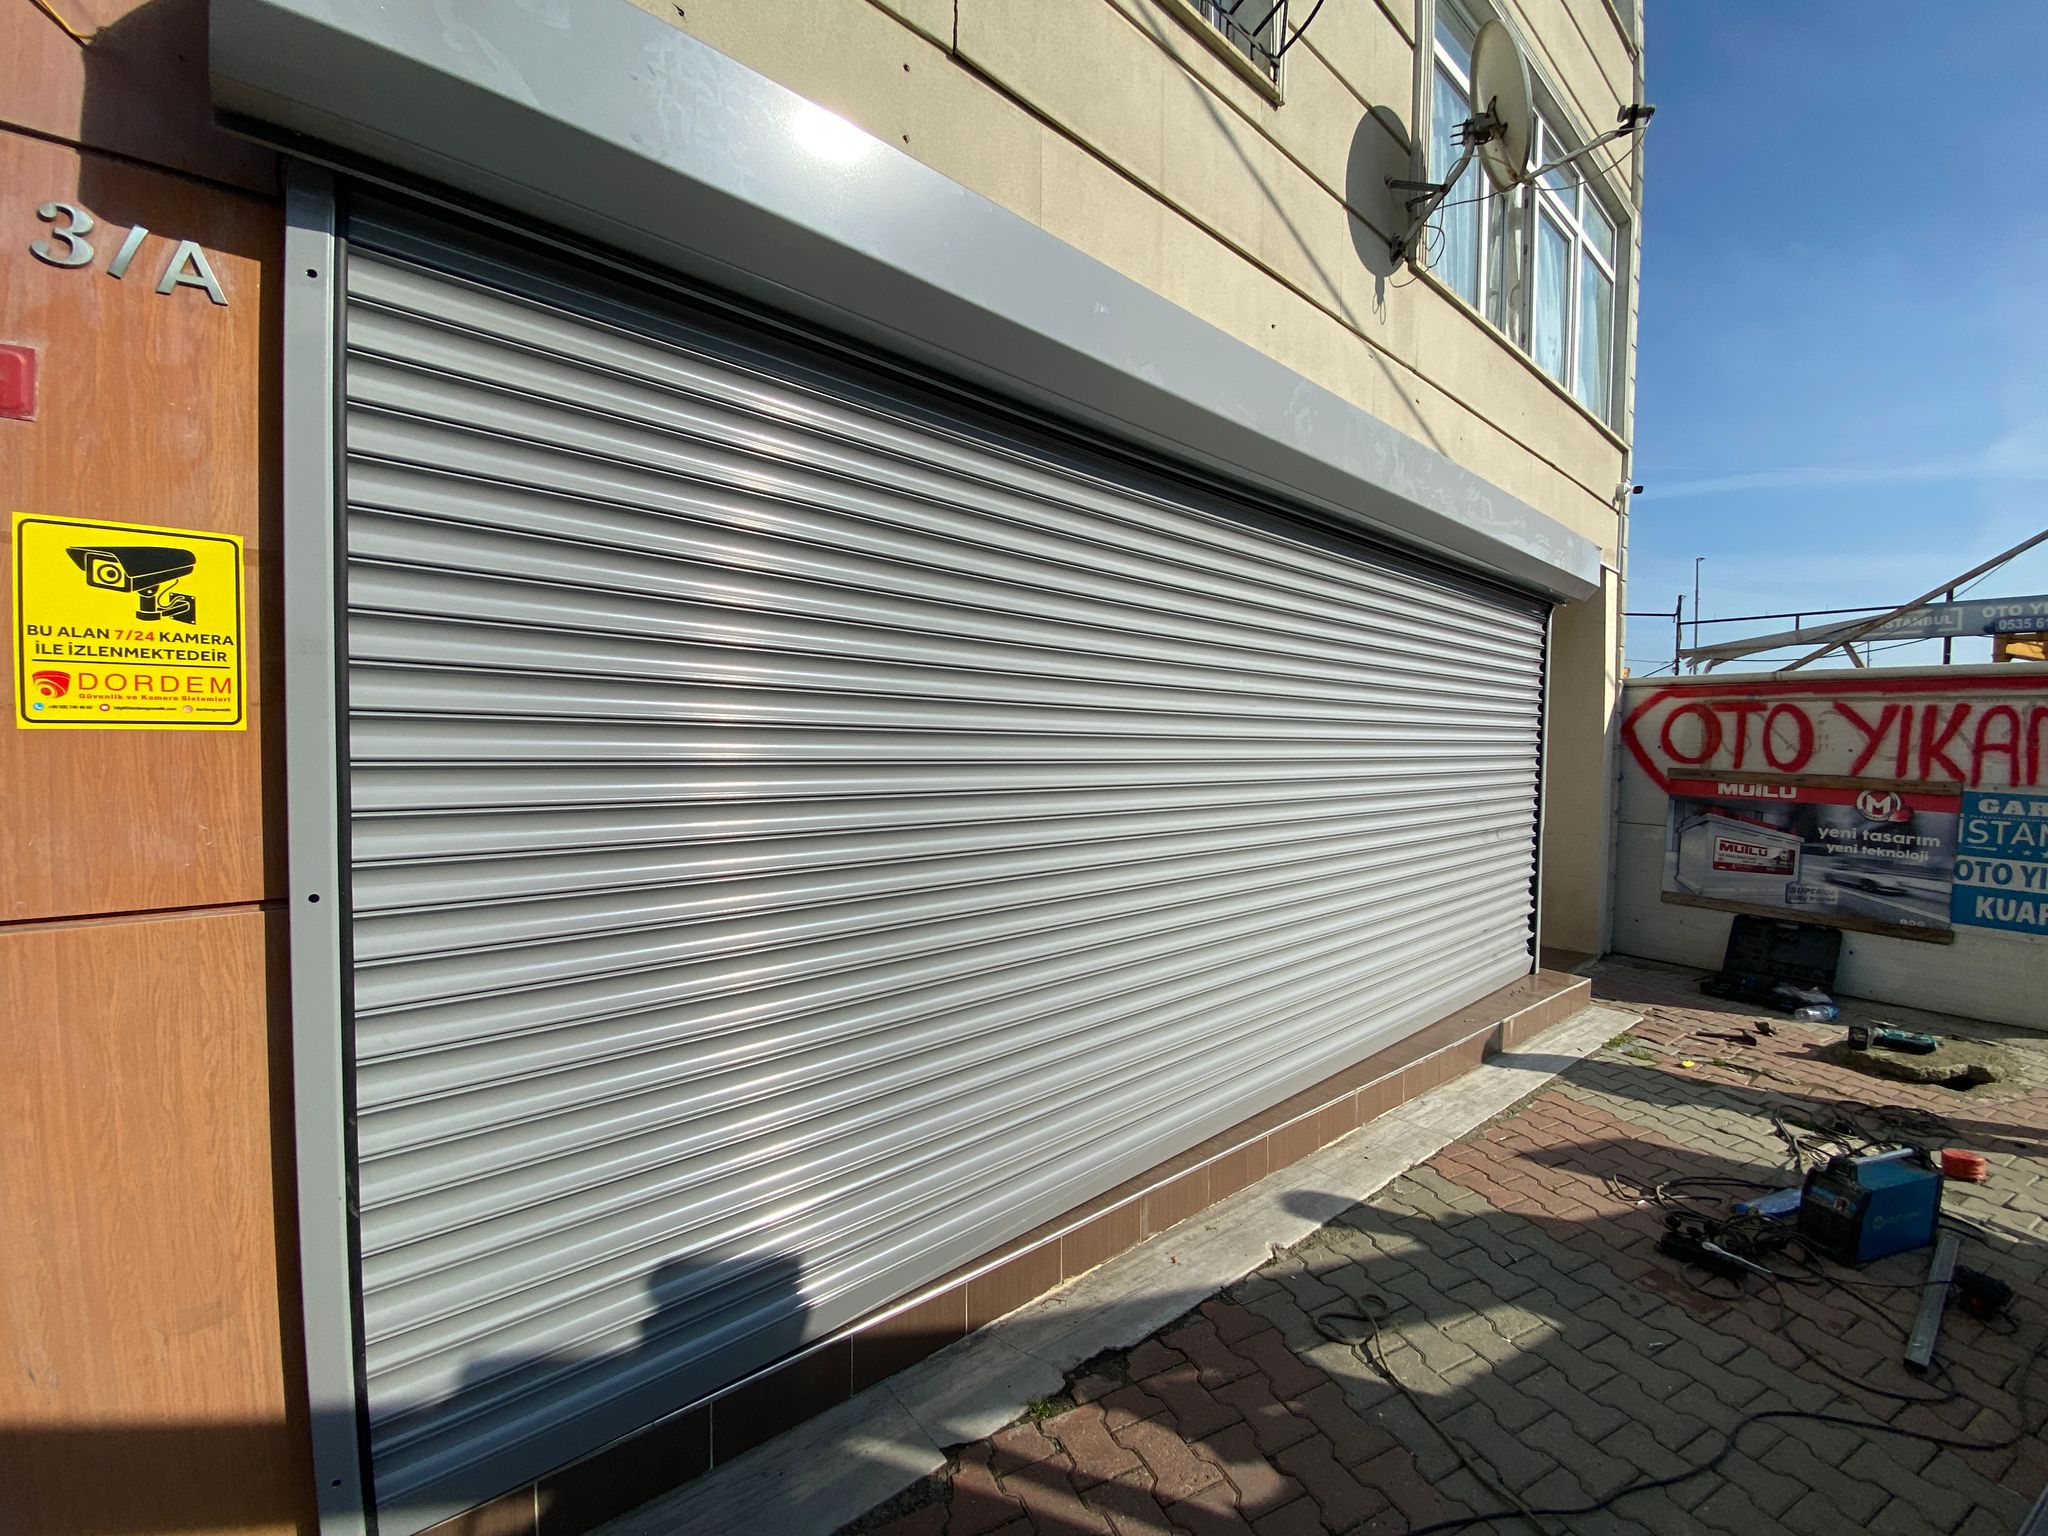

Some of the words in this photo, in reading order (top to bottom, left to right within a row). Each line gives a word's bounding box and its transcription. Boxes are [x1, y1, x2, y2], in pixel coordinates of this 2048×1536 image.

[1982, 604, 2023, 618] OTO
[1881, 615, 1953, 629] STANBUL
[1998, 618, 2032, 630] 0535
[27, 625, 52, 636] BU
[57, 626, 110, 639] ALAN
[114, 629, 155, 641] 7/24
[159, 631, 234, 646] KAMERA
[35, 640, 64, 655] İLE
[68, 642, 227, 662] İZLENMEKTEDEİR
[78, 672, 231, 694] DORDEM
[1661, 702, 1814, 772] OTO
[1818, 826, 1857, 839] yeni
[1862, 829, 1941, 848] tasarım
[1826, 843, 1858, 854] yeni
[1862, 845, 1929, 863] teknoloji
[1953, 859, 2013, 885] OTO
